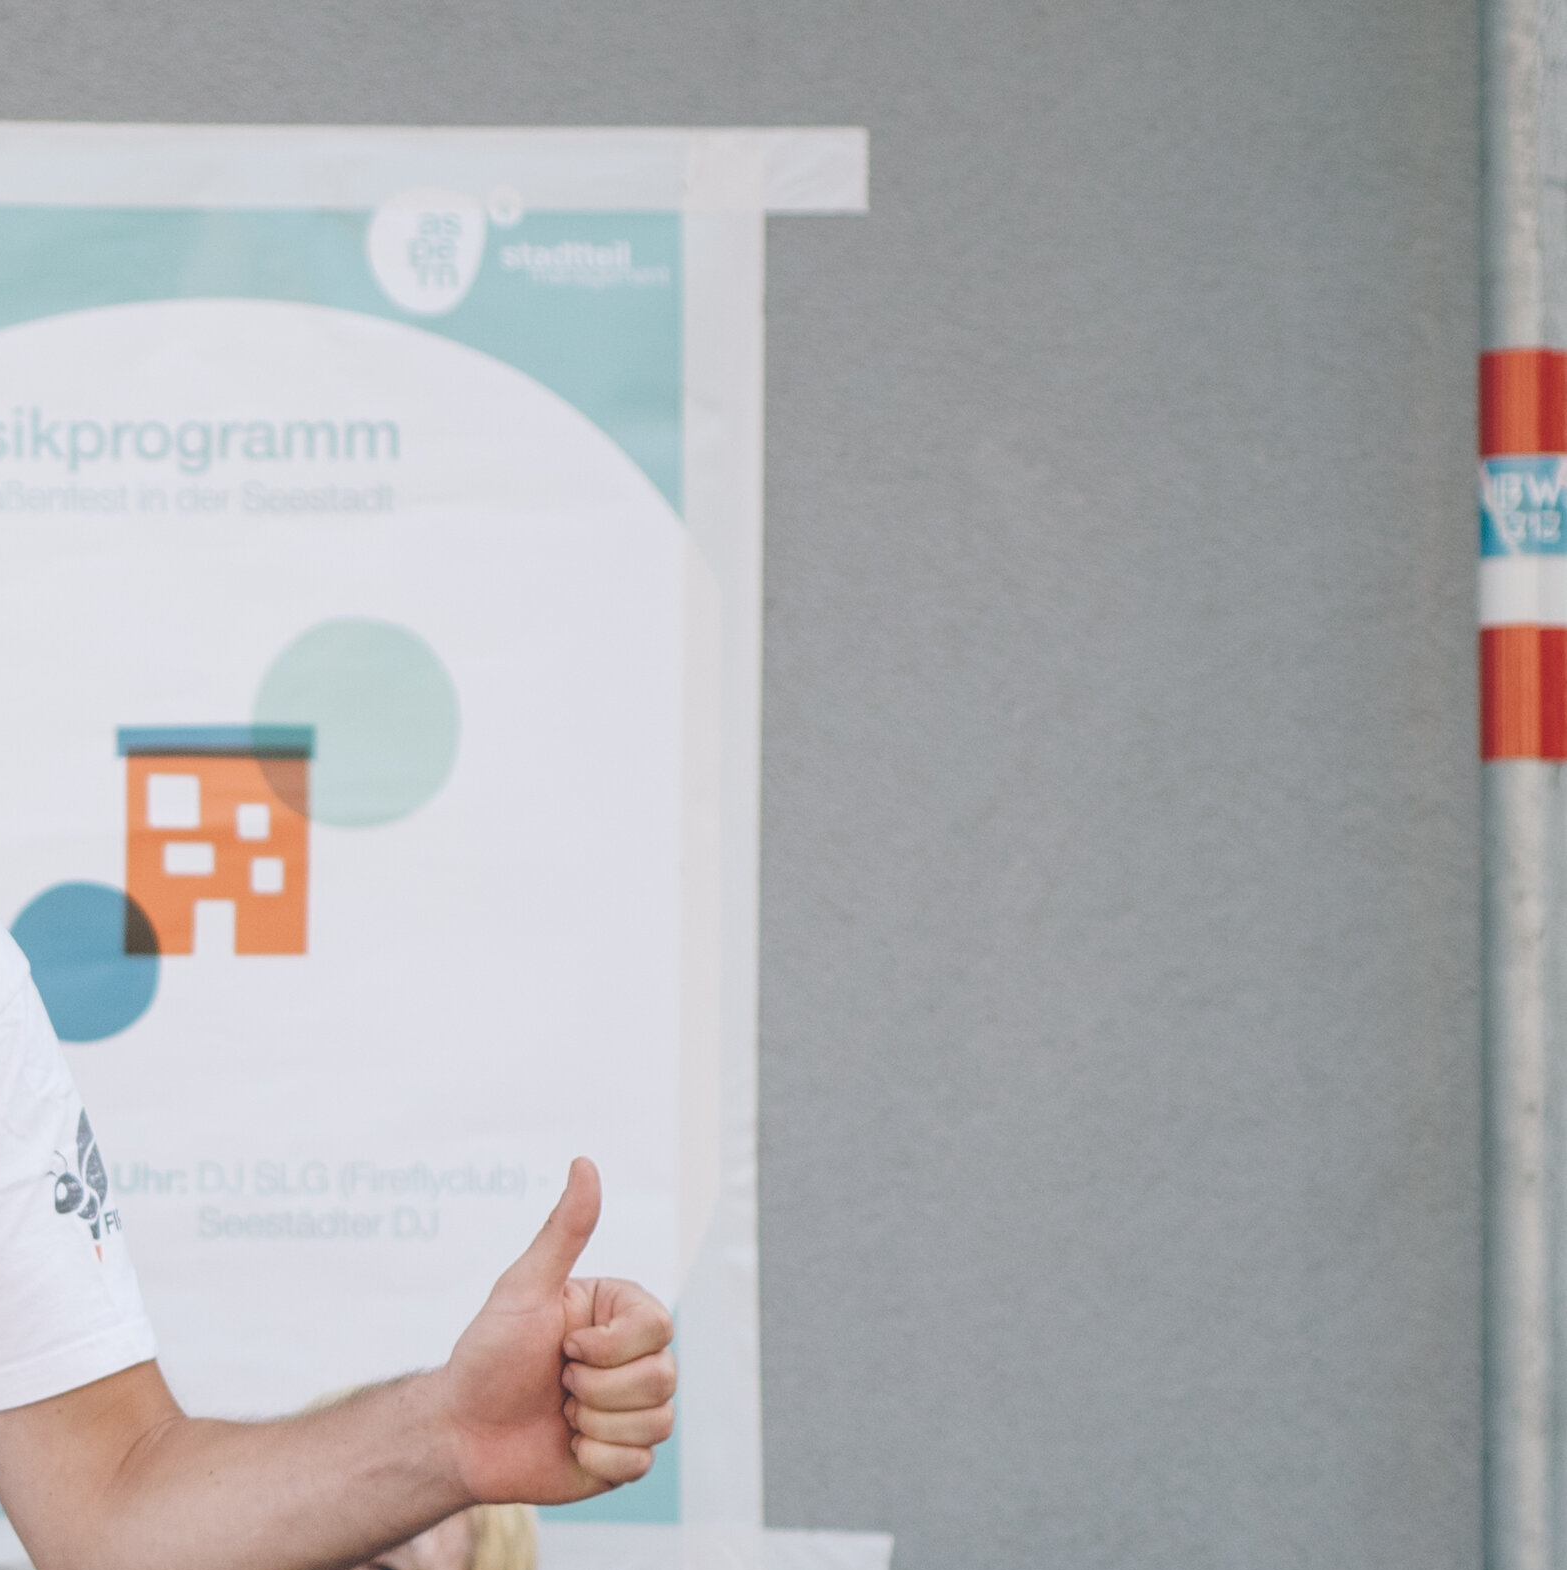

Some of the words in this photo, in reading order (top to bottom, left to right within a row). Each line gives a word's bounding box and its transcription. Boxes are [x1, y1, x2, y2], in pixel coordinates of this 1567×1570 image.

[139, 482, 167, 513] in
[177, 481, 229, 514] der
[243, 480, 395, 515] Seestadt
[113, 1162, 188, 1196] Uhr:
[197, 1163, 245, 1196] DJ
[253, 1163, 329, 1196] SLG
[339, 1160, 527, 1200] (Fireflyclub)
[196, 1206, 383, 1240] Seestädter
[392, 1208, 440, 1240] DJ
